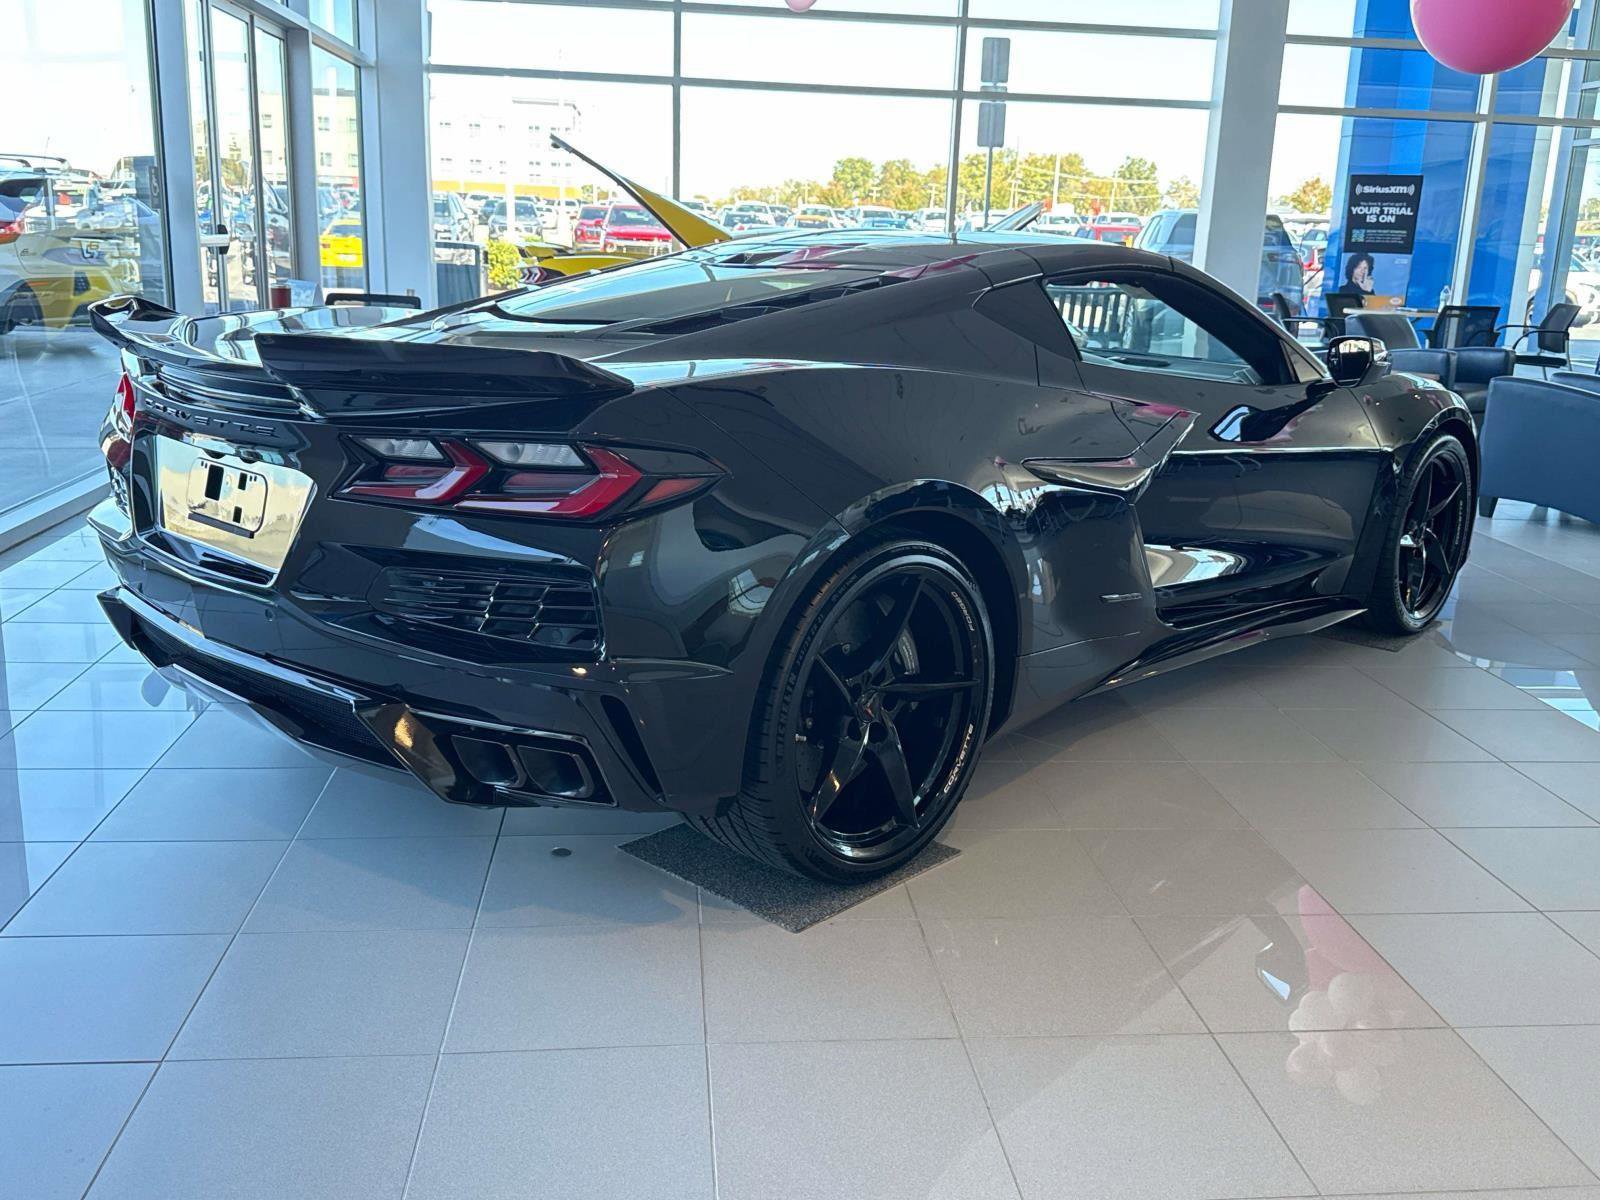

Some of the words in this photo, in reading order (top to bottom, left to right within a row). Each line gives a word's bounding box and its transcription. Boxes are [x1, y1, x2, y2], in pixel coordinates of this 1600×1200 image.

[1351, 206, 1381, 215] YOUR
[1382, 206, 1413, 216] TRIAL
[1366, 214, 1378, 223] IS
[1378, 214, 1396, 223] ON
[145, 398, 276, 437] CORVETTE
[949, 590, 976, 632] FORGED
[943, 722, 975, 794] CORVETTE
